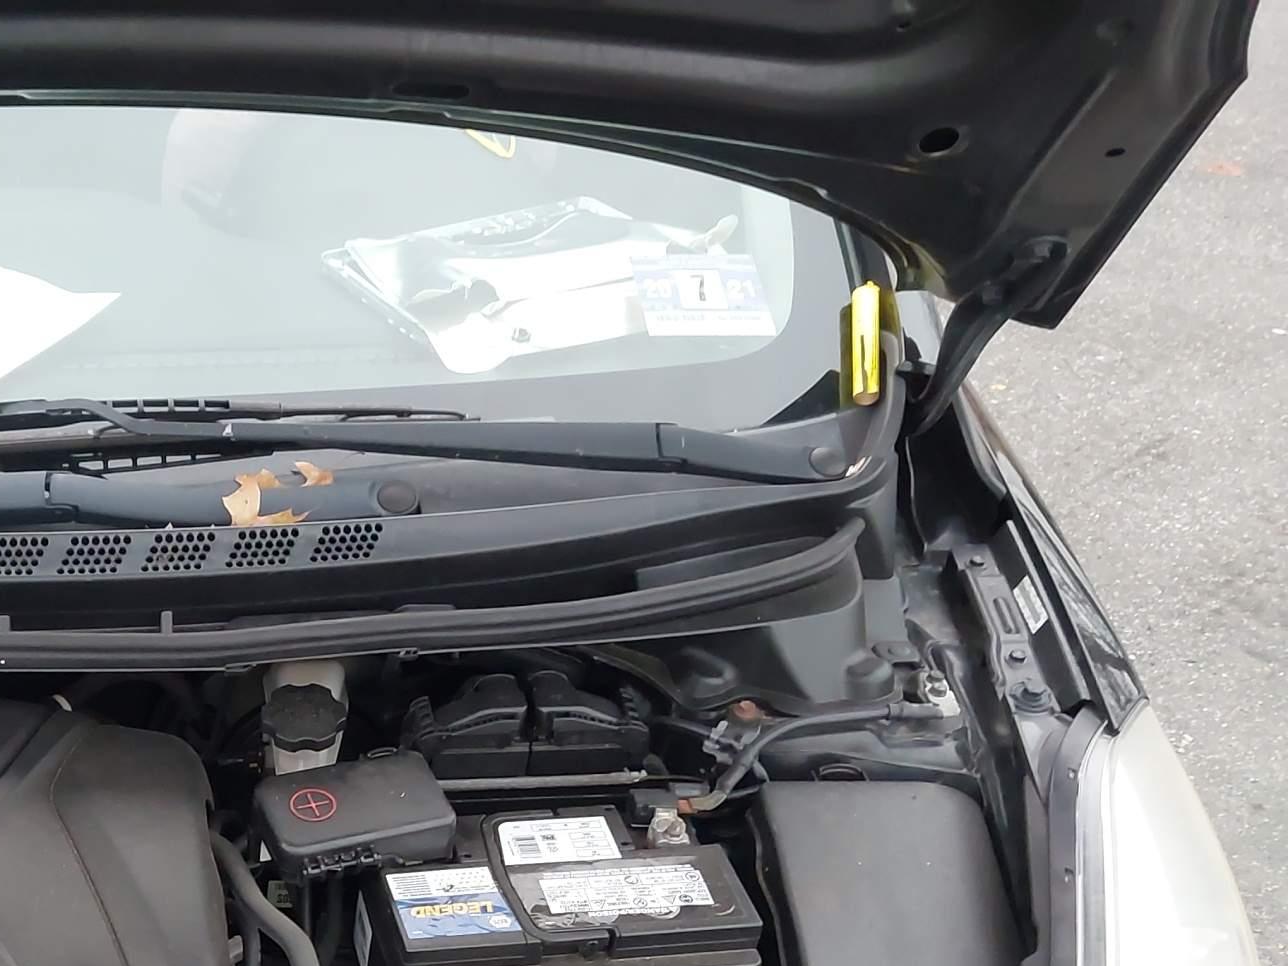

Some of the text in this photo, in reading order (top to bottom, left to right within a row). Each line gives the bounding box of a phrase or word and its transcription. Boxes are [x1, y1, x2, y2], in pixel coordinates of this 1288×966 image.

[690, 274, 706, 301] 7
[726, 278, 756, 298] 21
[410, 900, 494, 918] LEGEND
